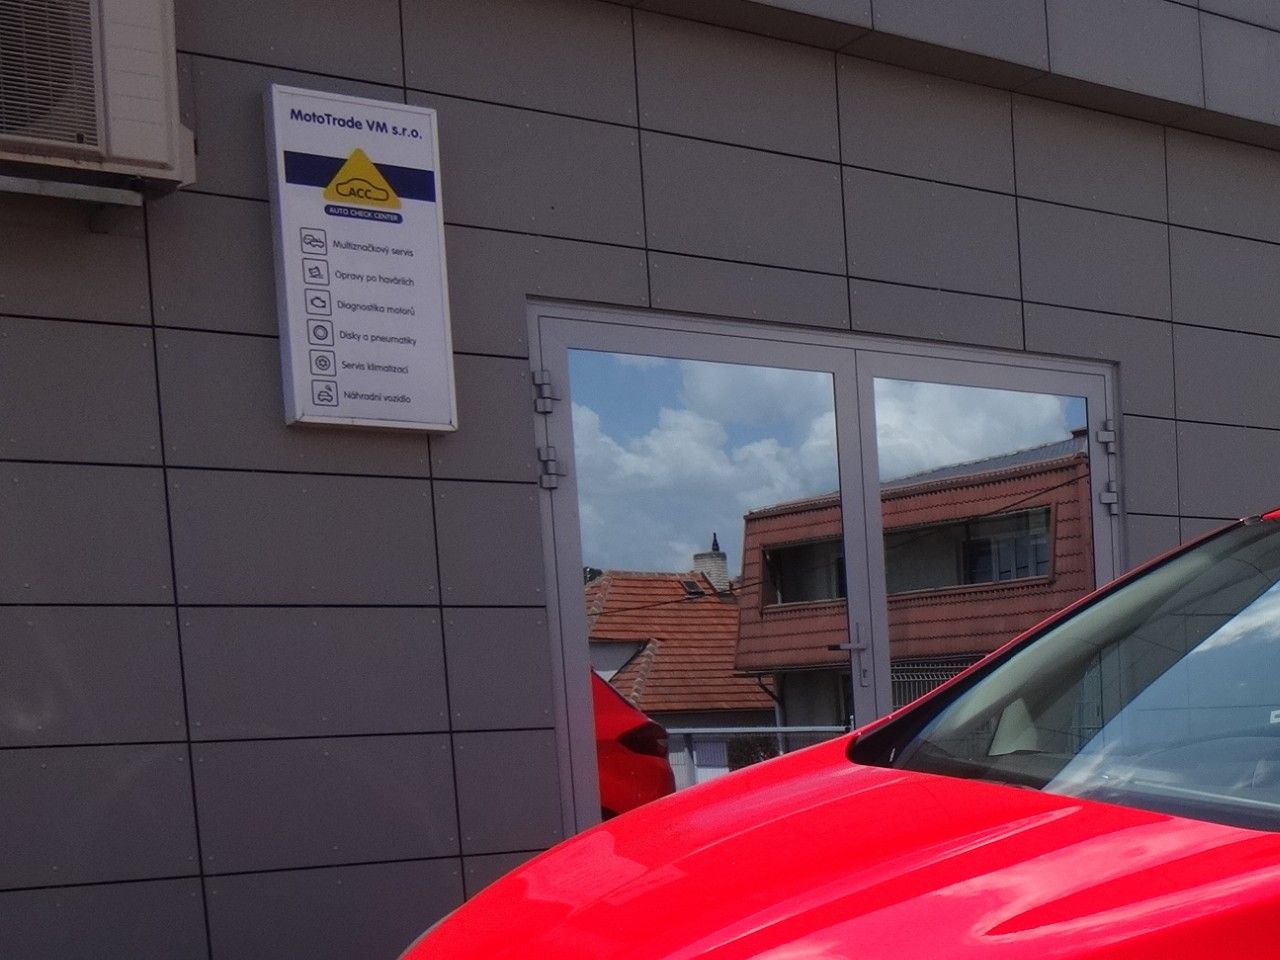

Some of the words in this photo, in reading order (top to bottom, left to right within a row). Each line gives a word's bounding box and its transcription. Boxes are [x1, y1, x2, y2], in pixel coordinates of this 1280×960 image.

[290, 108, 363, 130] MotoTrade
[366, 120, 388, 134] VM
[392, 126, 422, 139] s.r.o.
[350, 188, 371, 199] ACC
[329, 207, 349, 215] AUTO
[350, 210, 373, 219] CHECK
[373, 212, 399, 221] CENTER
[391, 248, 414, 257] servis
[335, 270, 364, 282] Opravy
[366, 275, 377, 283] po
[337, 300, 385, 312] Diagnostika
[339, 330, 361, 341] Disky
[371, 335, 417, 347] pneumatiky
[341, 361, 365, 371] Servis
[383, 395, 411, 403] vozidlo
